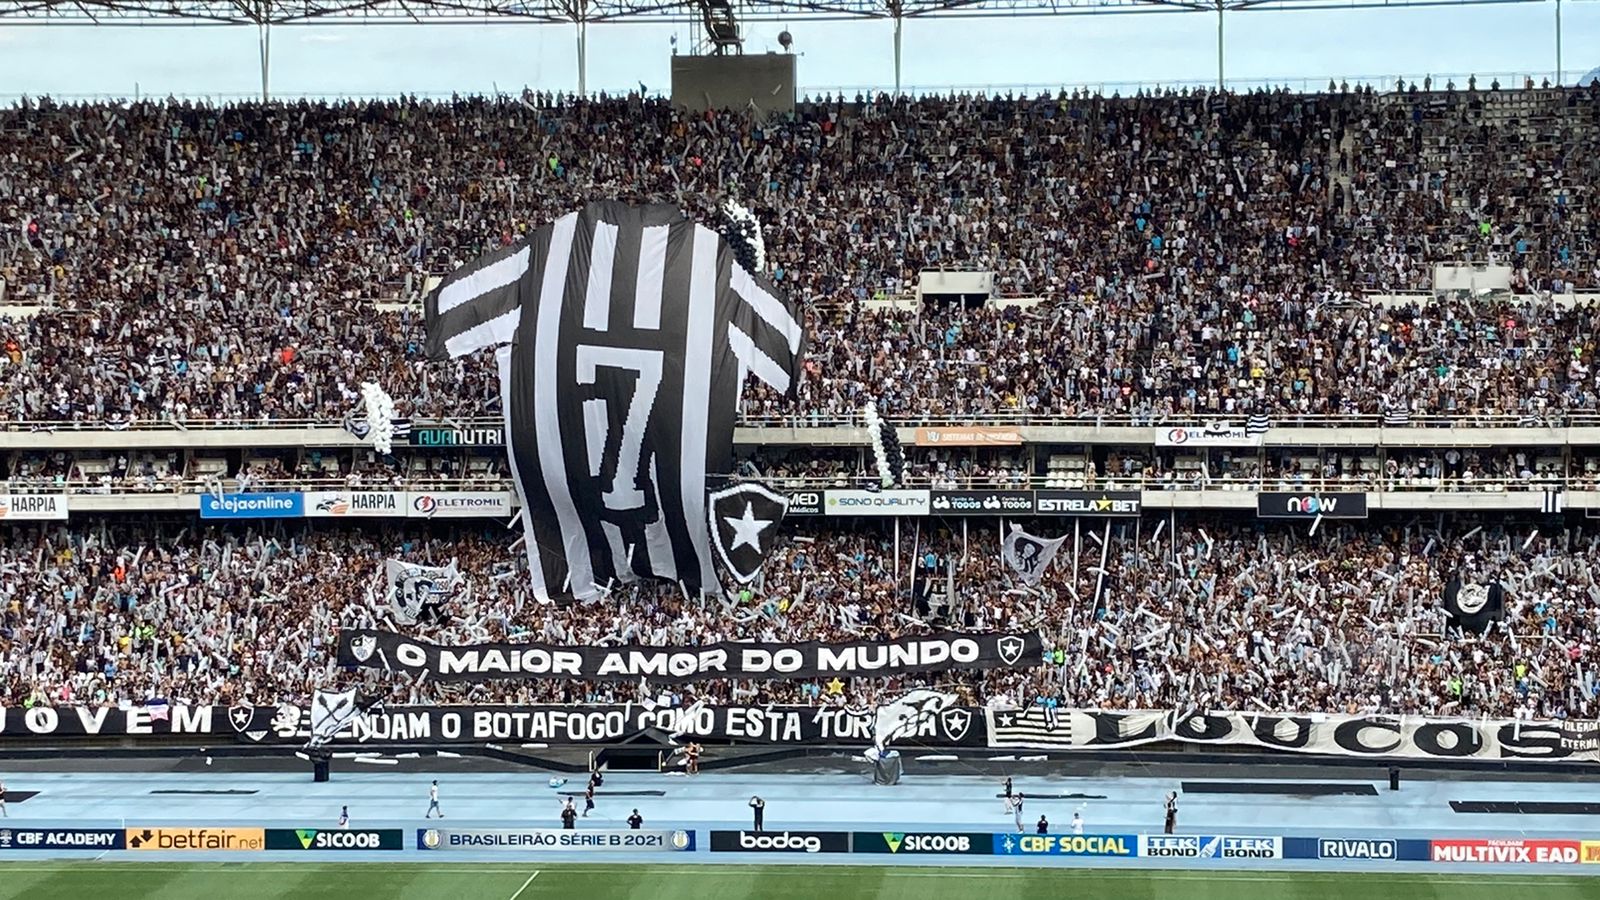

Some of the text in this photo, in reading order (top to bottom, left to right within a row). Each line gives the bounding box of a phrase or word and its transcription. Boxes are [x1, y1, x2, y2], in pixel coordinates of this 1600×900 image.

[576, 344, 664, 510] 7
[418, 429, 502, 445] AVANUTRI
[11, 497, 56, 512] HARPIA
[210, 497, 293, 513] elejaonline
[352, 494, 396, 510] HARPIA
[437, 498, 503, 507] ELETROMIL
[839, 498, 925, 506] SONO QUALITY
[1038, 499, 1139, 513] ESTRELA BET
[397, 643, 427, 668] O
[439, 650, 582, 675] MAIOR
[597, 650, 727, 677] AMOR
[742, 648, 803, 673] DO
[817, 638, 979, 672] MUNDO
[0, 706, 212, 734] OVEM
[441, 712, 461, 738] O
[474, 710, 624, 740] BOTAFOGO
[638, 708, 714, 736] COMO
[725, 708, 801, 741] ESTA
[819, 708, 937, 739] TORA
[16, 832, 115, 847] CBF ACADEMY
[159, 830, 263, 849] betfair.net
[316, 833, 380, 847] SICOOB
[450, 831, 663, 846] BRASILEIRÃO SÉRIE B 2021
[740, 831, 820, 853] bodog
[904, 836, 970, 851] SICOOB
[1019, 837, 1130, 854] CBF SOCIAL
[1147, 837, 1198, 848] TEK
[1224, 838, 1275, 849] TEK
[1147, 848, 1198, 857] BOND
[1224, 849, 1275, 858] BOND
[1323, 840, 1393, 858] RIVALO
[1433, 845, 1530, 863] MULTIVIX
[1536, 846, 1578, 863] EAD
